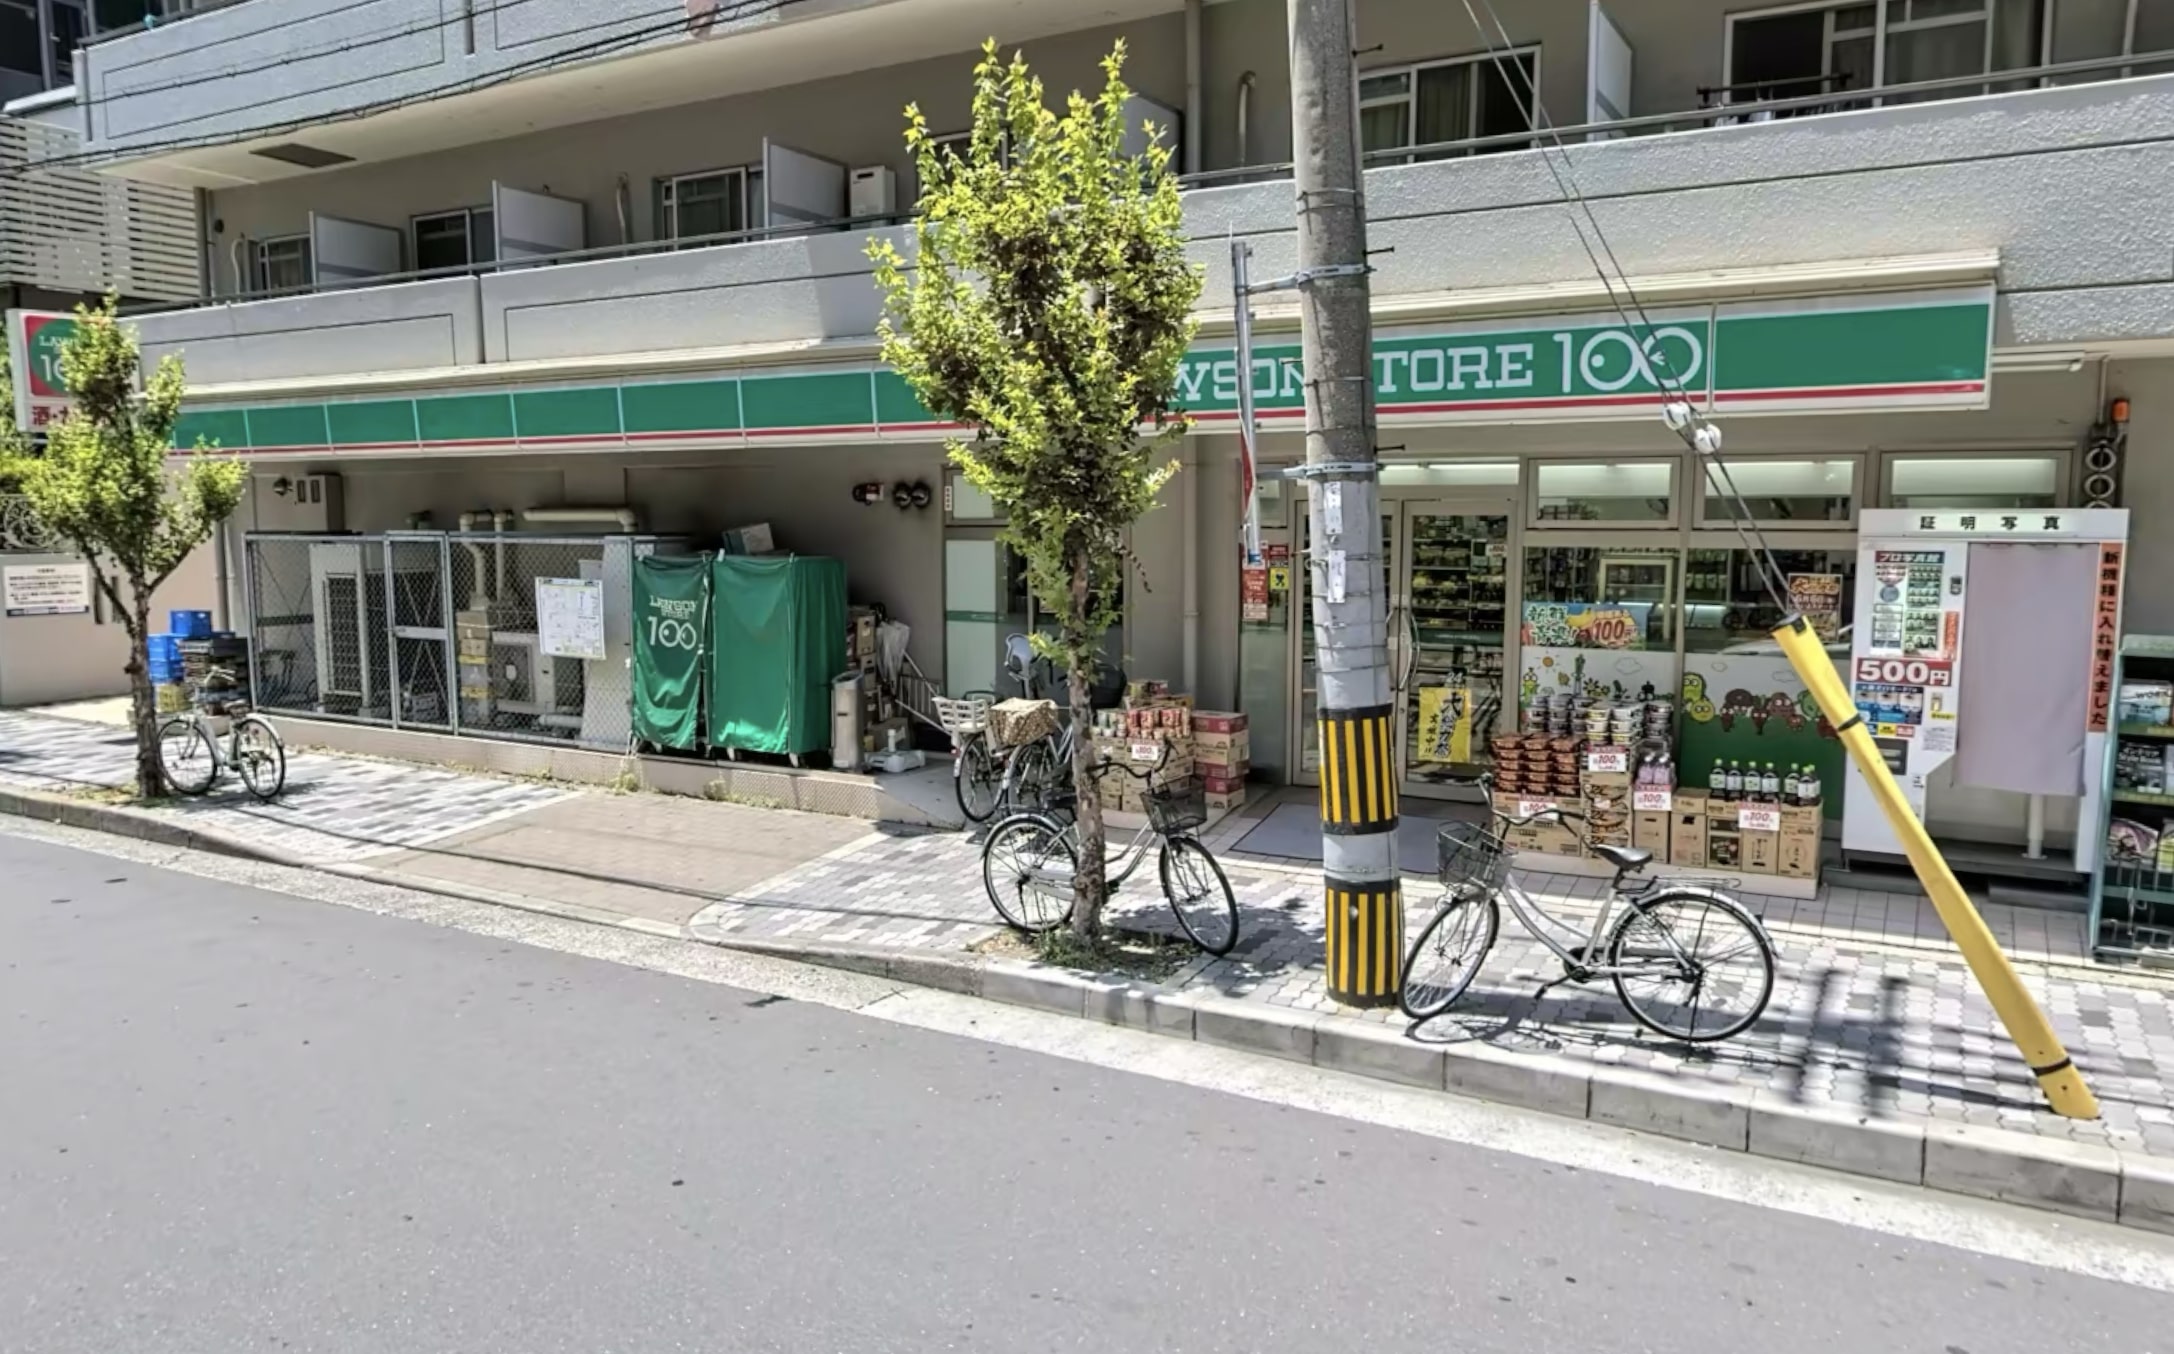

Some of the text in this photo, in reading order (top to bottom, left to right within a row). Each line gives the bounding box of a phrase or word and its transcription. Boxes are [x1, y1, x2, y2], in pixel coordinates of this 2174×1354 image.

[1170, 327, 1702, 403] WSON TORE 100
[1920, 516, 2060, 530] 証明写真
[647, 615, 697, 650] 100
[1858, 660, 1949, 686] 500円
